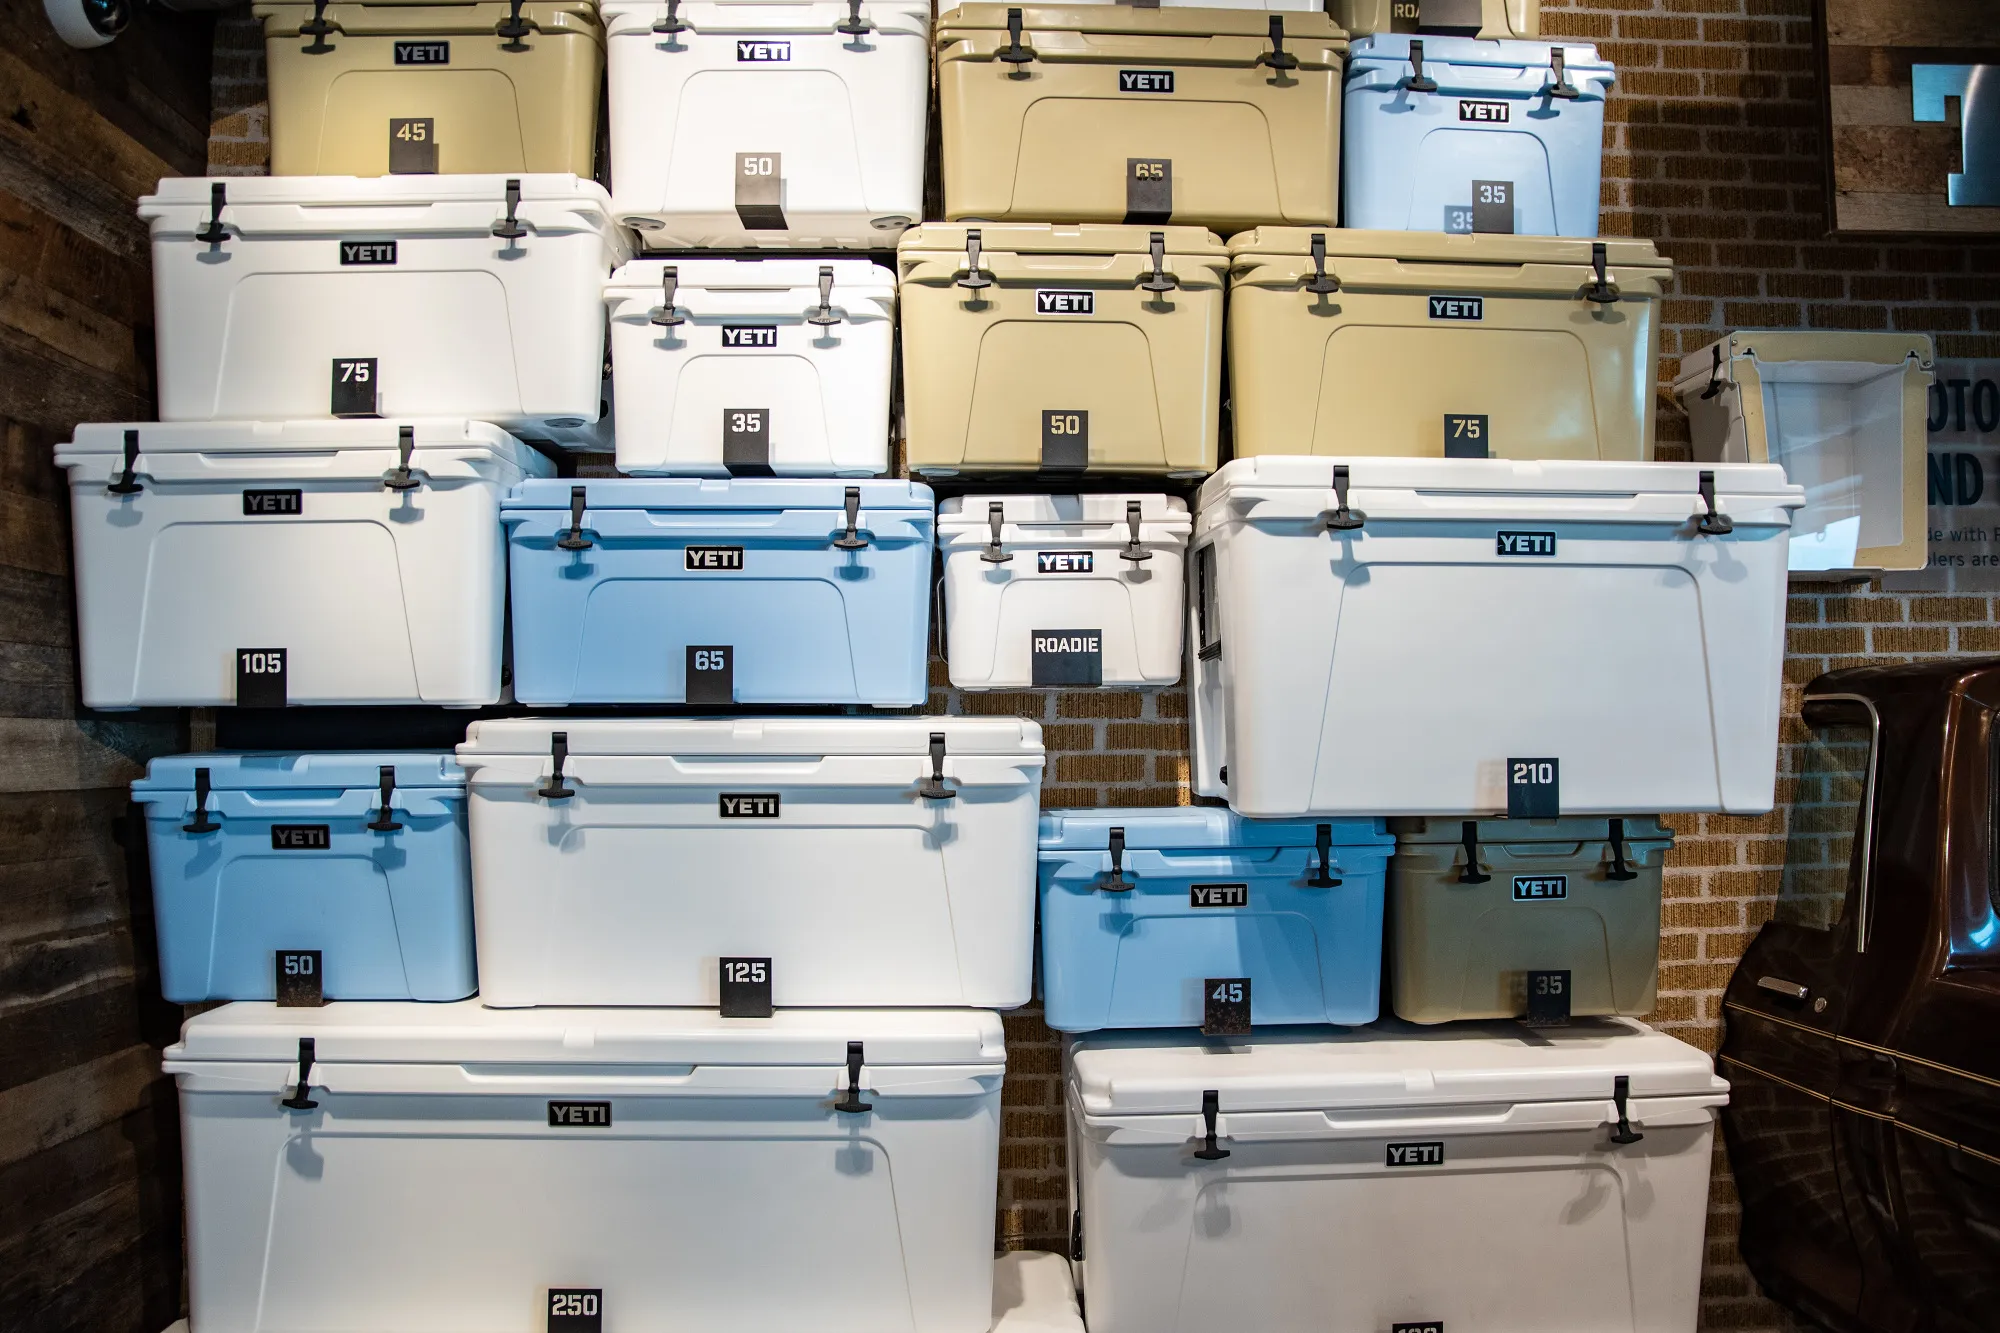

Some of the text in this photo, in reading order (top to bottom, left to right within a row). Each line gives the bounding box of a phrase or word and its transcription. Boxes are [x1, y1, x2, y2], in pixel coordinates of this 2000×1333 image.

[397, 45, 445, 61] YETI
[738, 42, 790, 60] YETI
[1121, 73, 1170, 90] YETI
[1461, 103, 1508, 121] YETI
[396, 123, 426, 142] 45
[744, 157, 773, 176] 50
[1134, 162, 1165, 182] 65
[1480, 184, 1506, 204] 35
[343, 245, 393, 262] YETI
[1039, 293, 1092, 311] YETI
[1431, 300, 1479, 317] YETI
[724, 328, 776, 345] YETI
[340, 362, 370, 383] 75
[731, 413, 761, 433] 35
[1050, 415, 1080, 435] 50
[1452, 419, 1480, 439] 75
[247, 494, 297, 511] YETI
[1950, 526, 1987, 540] with
[1502, 535, 1552, 553] YETI
[688, 550, 739, 567] YETI
[1039, 554, 1091, 571] YETI
[1035, 637, 1099, 653] ROADIE
[242, 653, 281, 674] 105
[695, 650, 725, 671] 65
[1513, 763, 1553, 784] 210
[722, 798, 775, 814] YETI
[275, 829, 325, 845] YETI
[1193, 887, 1243, 904] YETI
[1516, 879, 1563, 896] YETI
[285, 955, 314, 975] 50
[725, 962, 766, 983] 125
[1212, 983, 1243, 1003] 45
[1536, 975, 1563, 995] 35
[551, 1106, 606, 1123] YETI
[1389, 1145, 1440, 1163] YETI
[552, 1294, 598, 1316] 250
